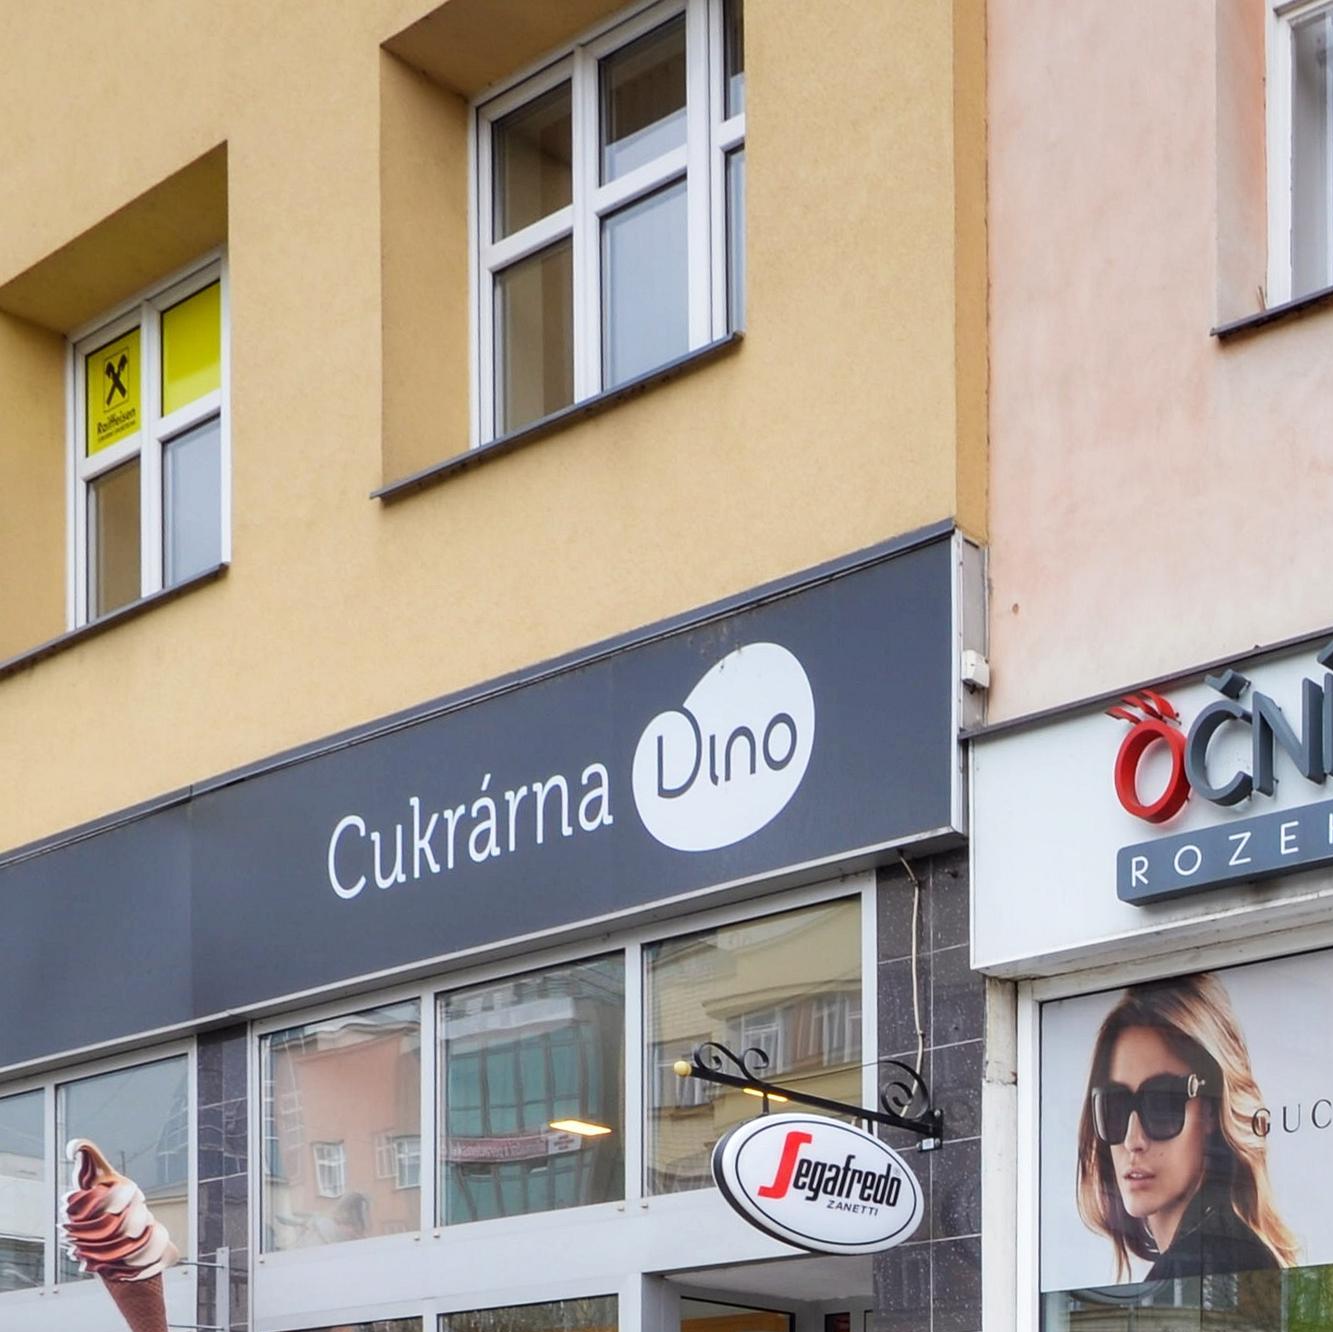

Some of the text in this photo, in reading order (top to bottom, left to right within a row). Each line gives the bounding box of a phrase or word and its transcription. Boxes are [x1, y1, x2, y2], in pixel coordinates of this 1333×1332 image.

[327, 704, 798, 899] Cukrárna Dino
[757, 1130, 902, 1208] Segafredo
[826, 1199, 879, 1217] ZANETTI
